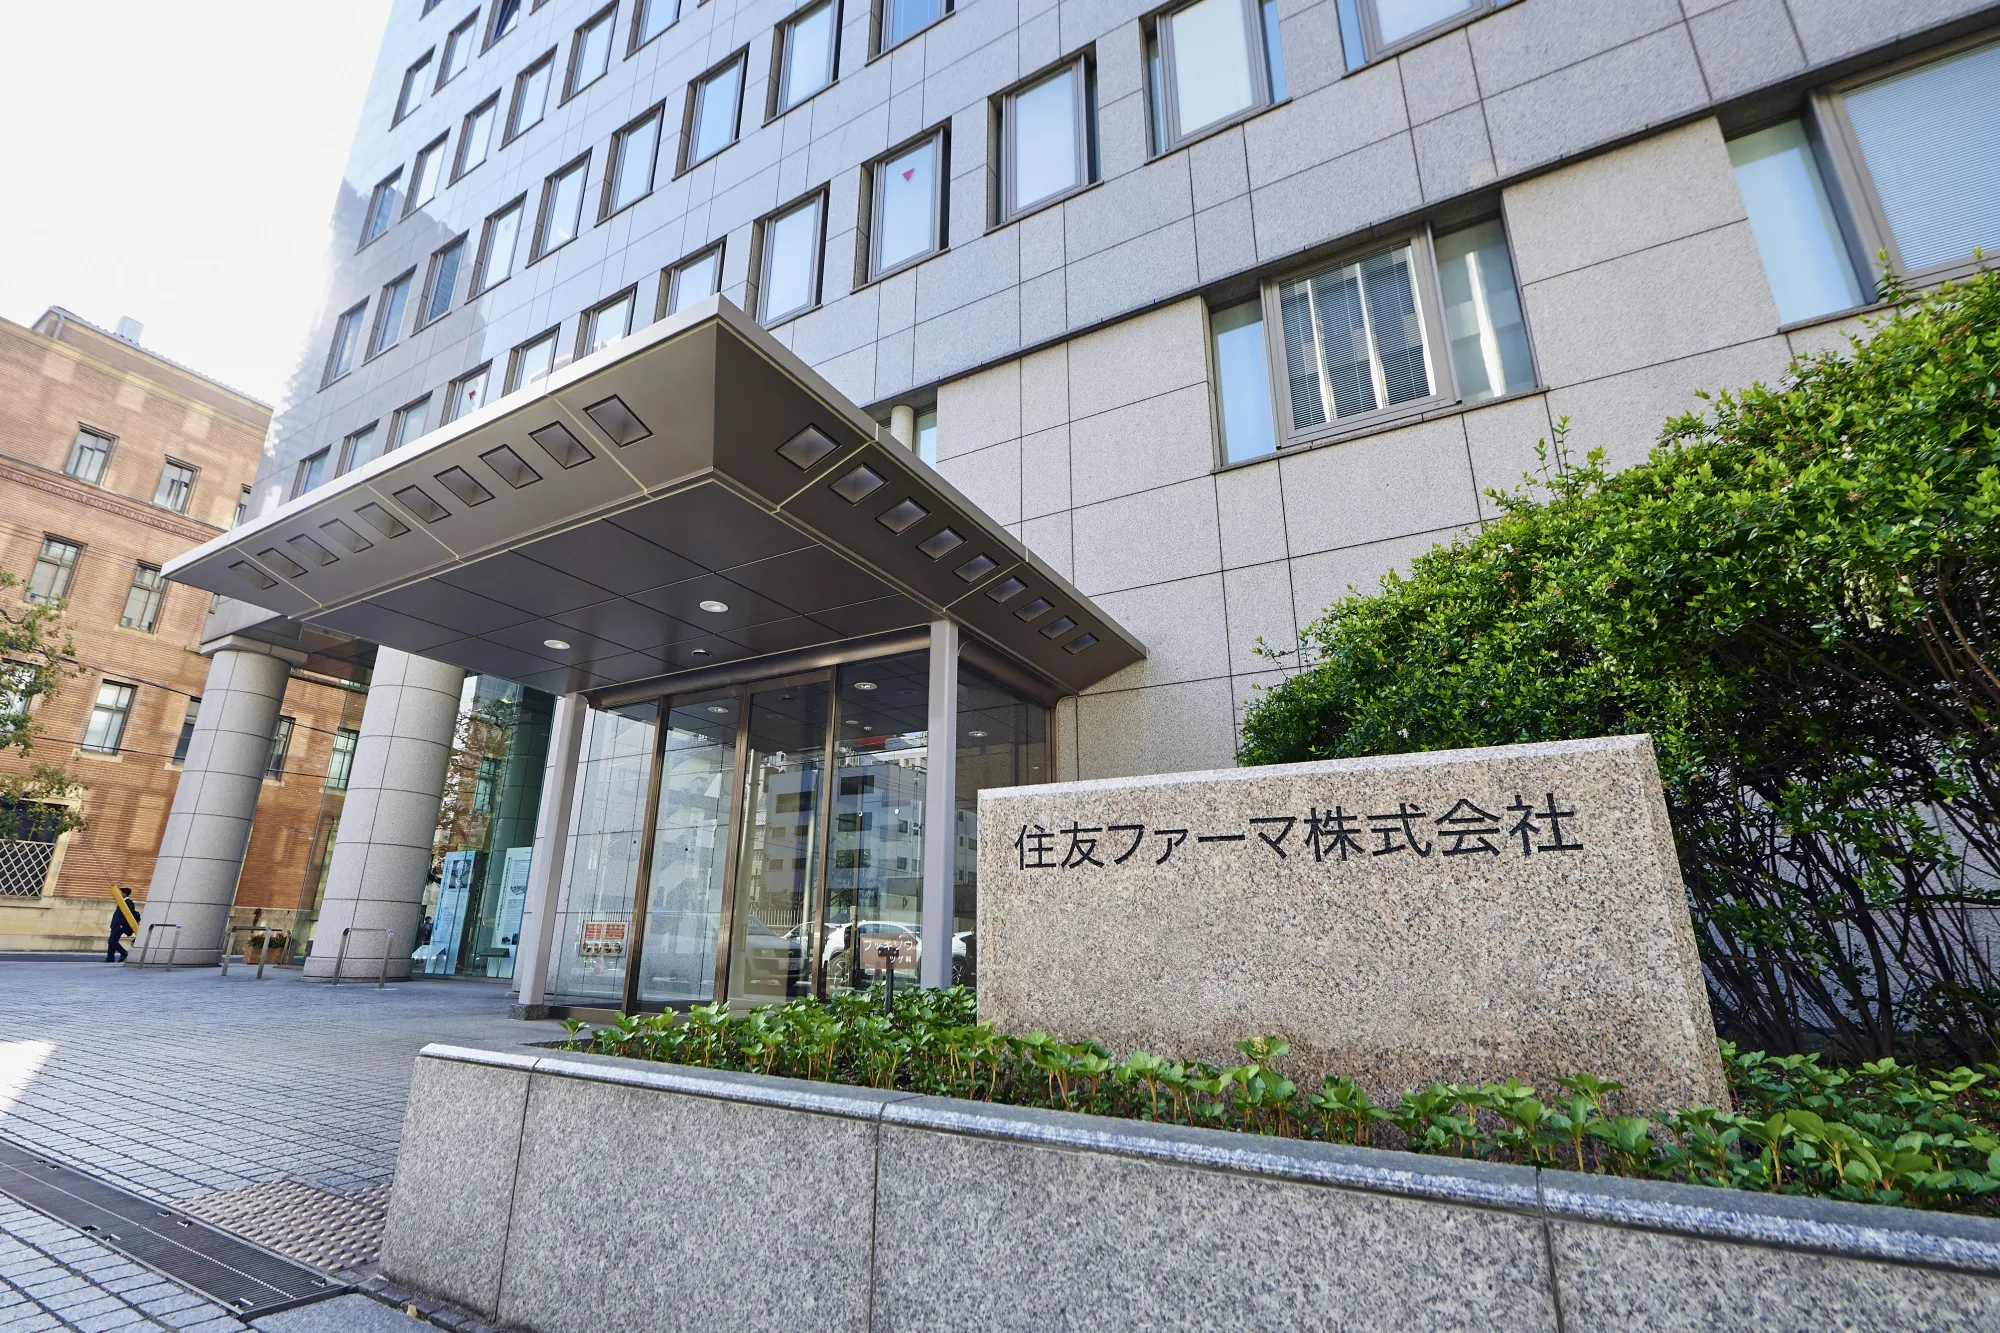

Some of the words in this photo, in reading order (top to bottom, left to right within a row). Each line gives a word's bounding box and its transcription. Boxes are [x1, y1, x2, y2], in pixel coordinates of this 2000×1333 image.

[1013, 792, 1585, 870] 住友ファーマ株式会社
[863, 939, 913, 951] フッキソウ
